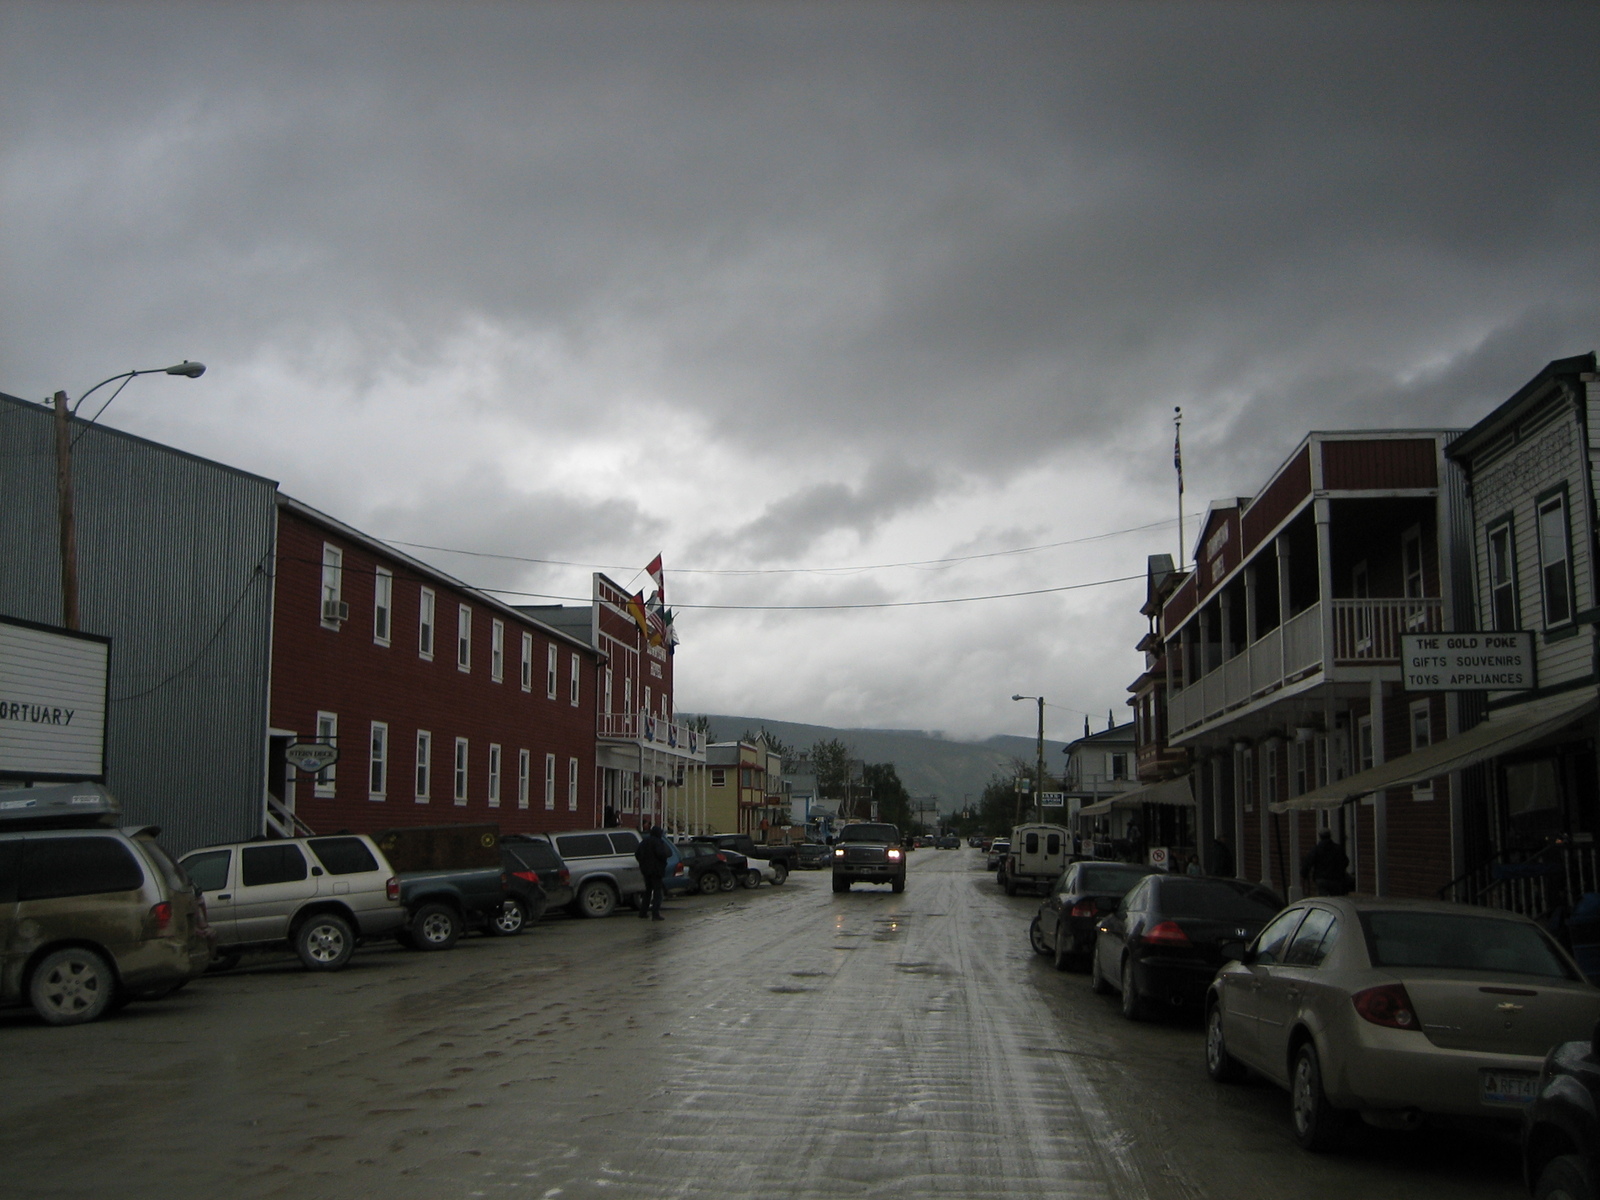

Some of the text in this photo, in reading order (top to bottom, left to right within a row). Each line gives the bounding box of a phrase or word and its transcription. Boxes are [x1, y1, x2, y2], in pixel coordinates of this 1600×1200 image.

[1416, 636, 1517, 650] THE GOLD POKE
[1412, 655, 1522, 668] GIFTS SOUVENIRS
[1408, 673, 1523, 685] TOYS APPLIANCES
[0, 701, 75, 726] ORTUARY
